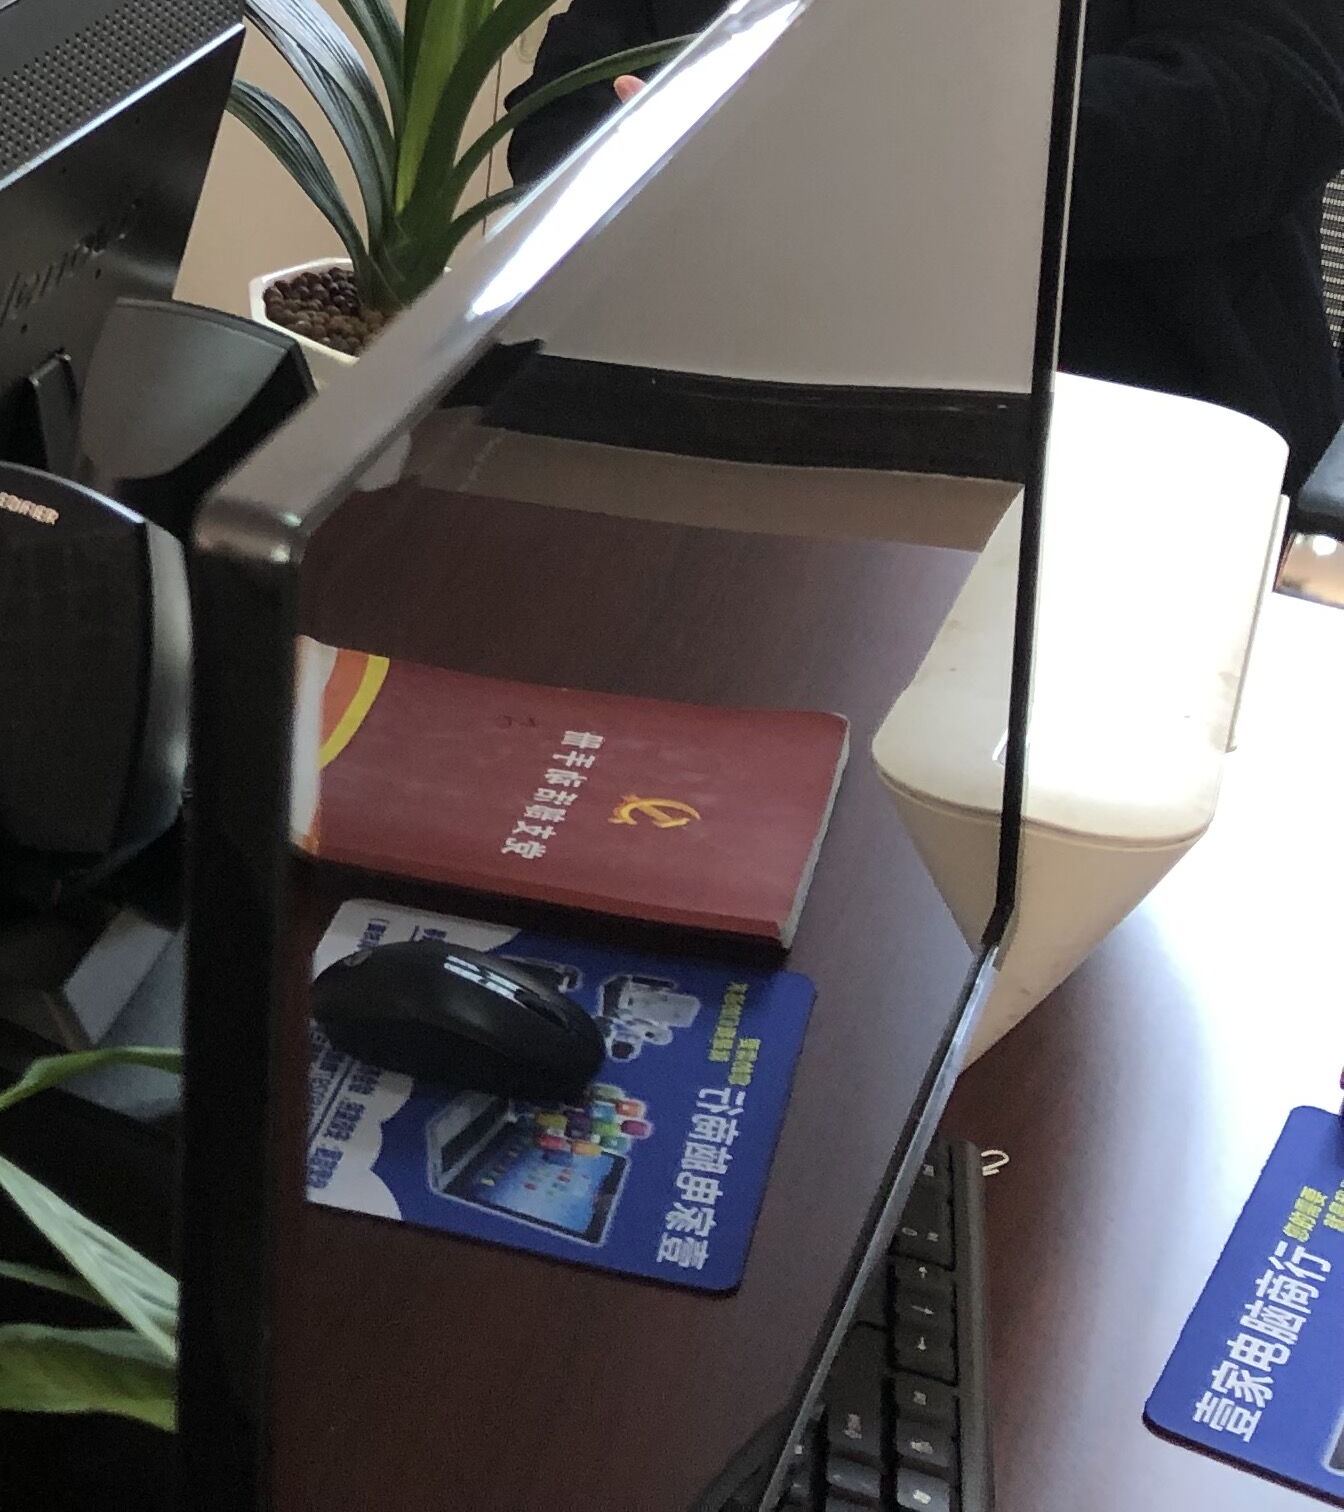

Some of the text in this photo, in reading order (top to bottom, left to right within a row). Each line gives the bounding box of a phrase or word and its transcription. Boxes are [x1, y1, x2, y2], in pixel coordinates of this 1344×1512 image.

[1192, 1240, 1332, 1444] 壹家电脑商行
